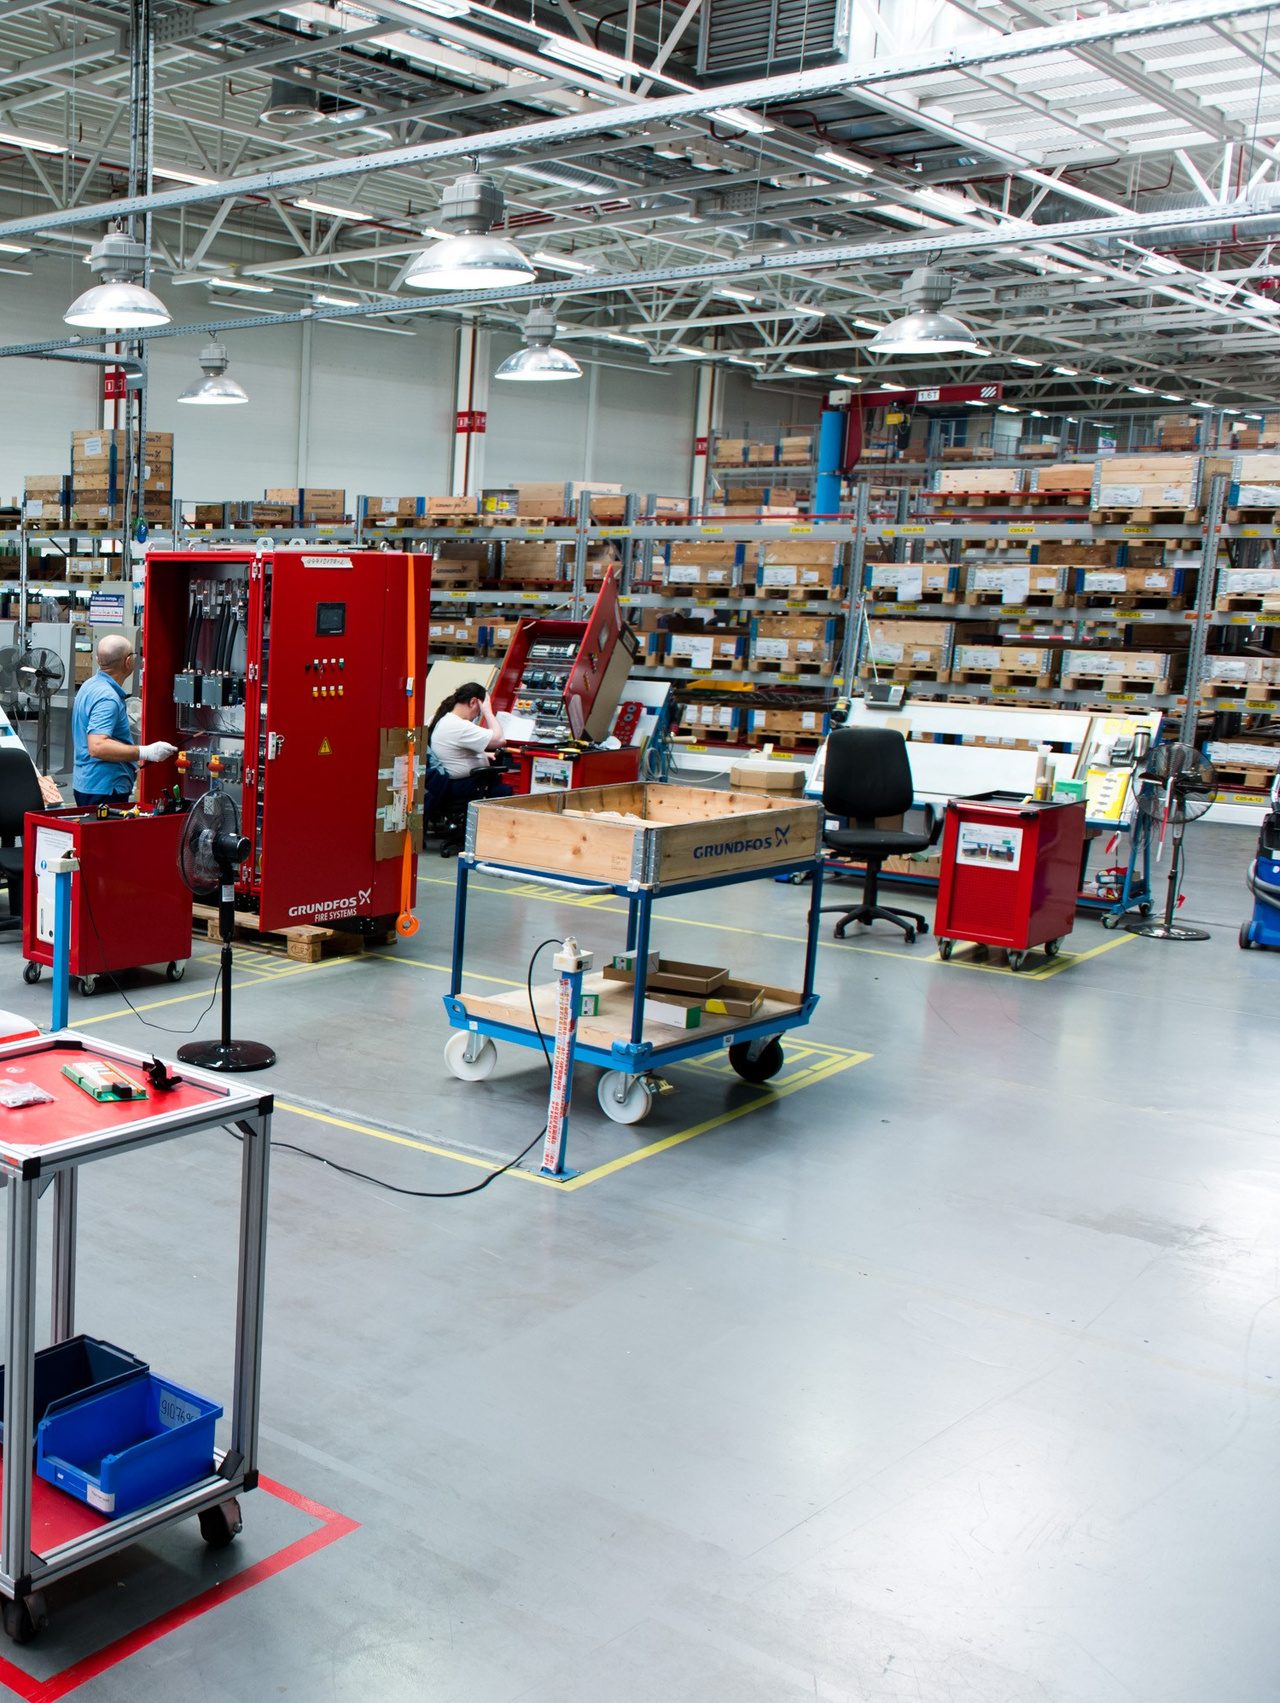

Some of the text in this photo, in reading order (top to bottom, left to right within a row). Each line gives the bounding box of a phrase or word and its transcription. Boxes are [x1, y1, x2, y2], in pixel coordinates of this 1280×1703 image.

[1235, 795, 1262, 803] C05-A-12
[693, 836, 772, 859] GRUNDFOS
[288, 896, 357, 917] GRUNDFOS
[314, 908, 357, 923] FIRE SYSTEMS
